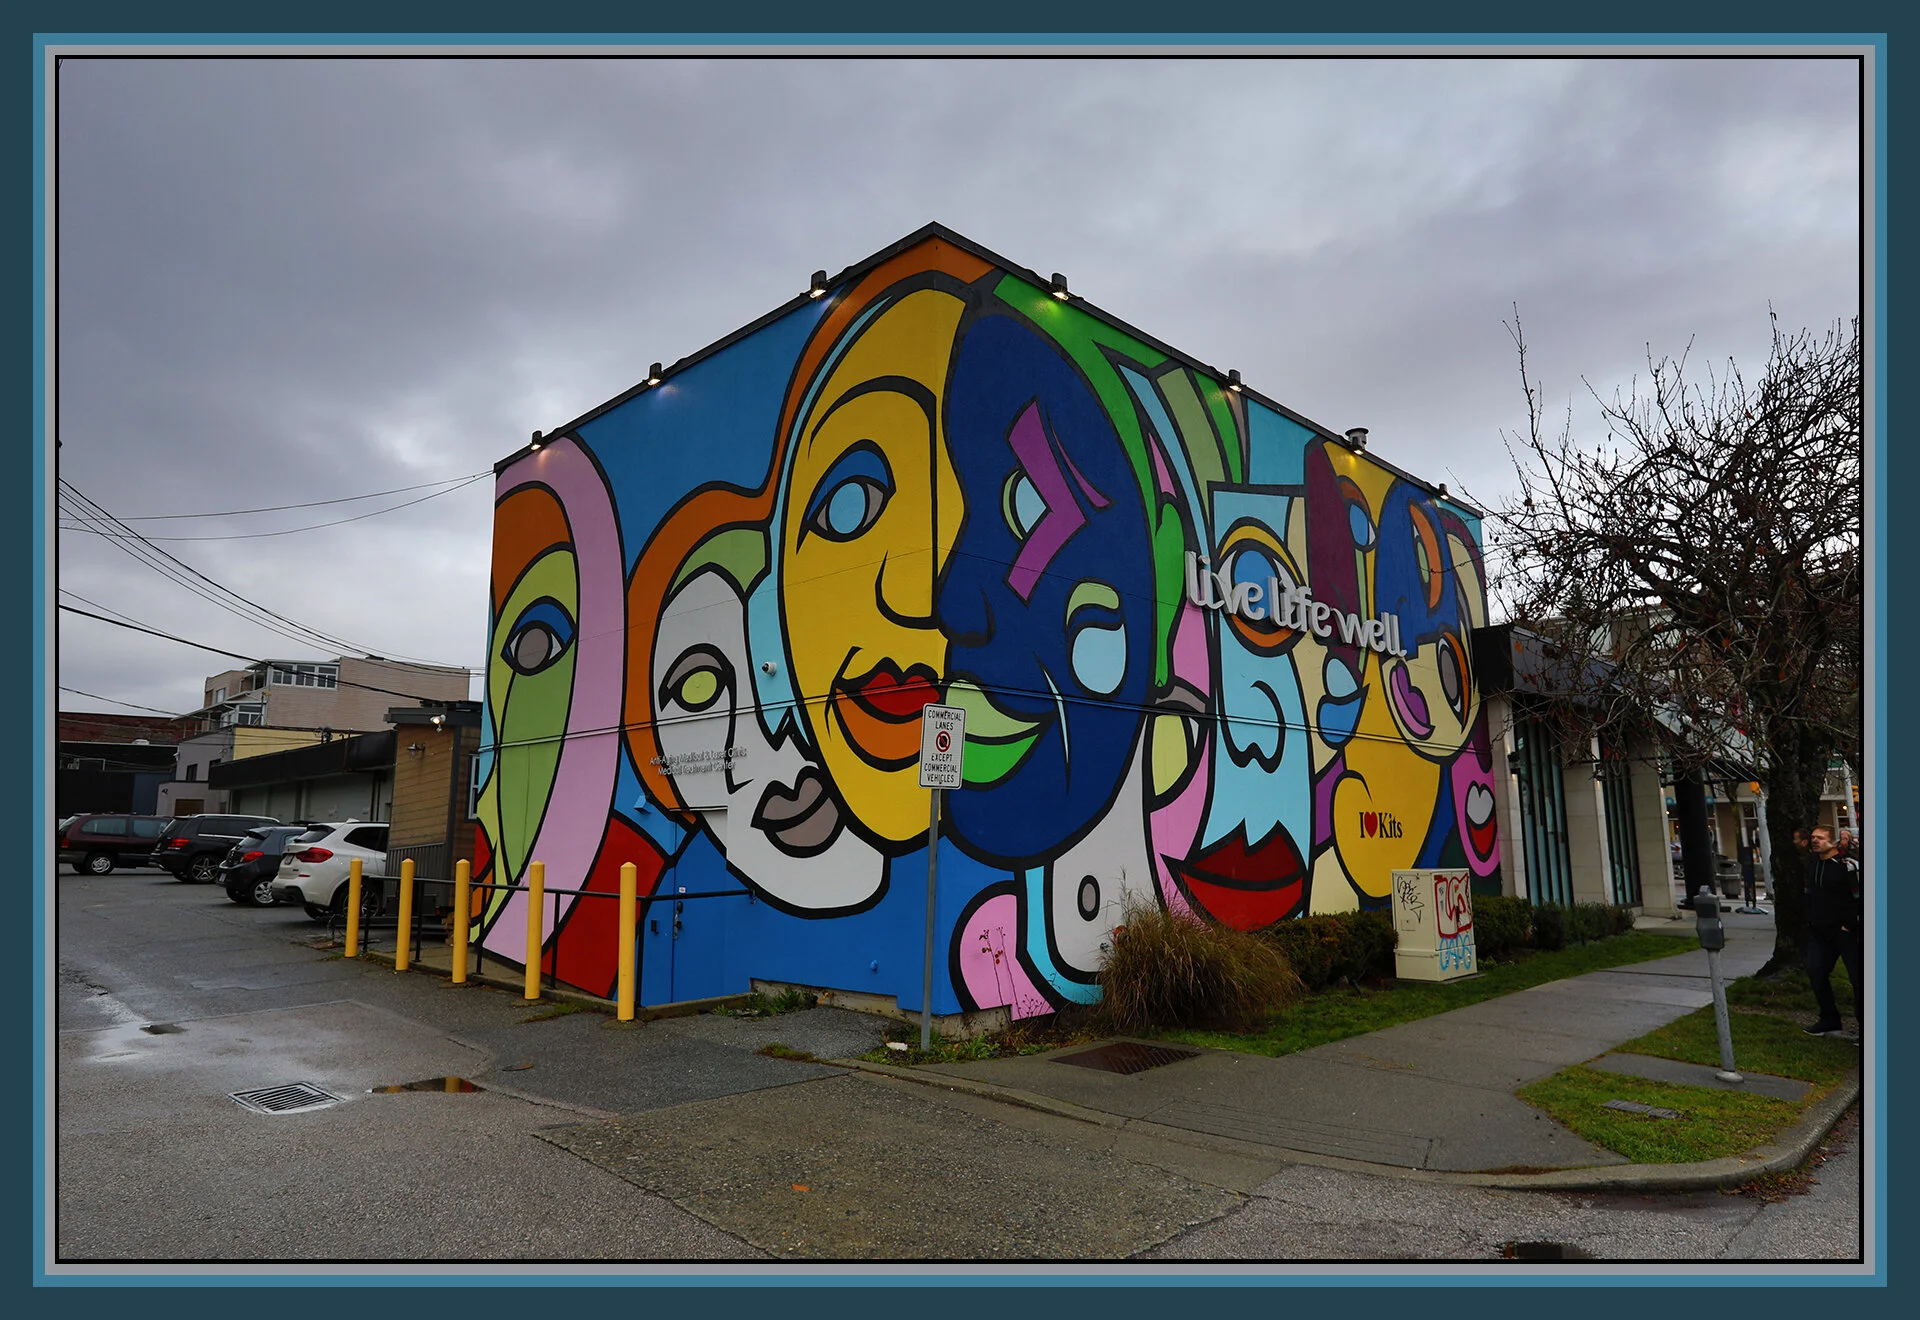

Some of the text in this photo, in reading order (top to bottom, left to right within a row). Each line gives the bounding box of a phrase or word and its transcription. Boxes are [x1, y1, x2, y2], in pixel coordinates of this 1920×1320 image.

[1185, 551, 1407, 657] live life well
[928, 710, 962, 721] COMMERCIAL
[935, 721, 953, 730] LANES
[931, 753, 952, 762] EXCEPT
[924, 763, 957, 773] COMMERCIAL
[927, 773, 954, 783] VEHICLES
[1359, 812, 1403, 839] I Kits
